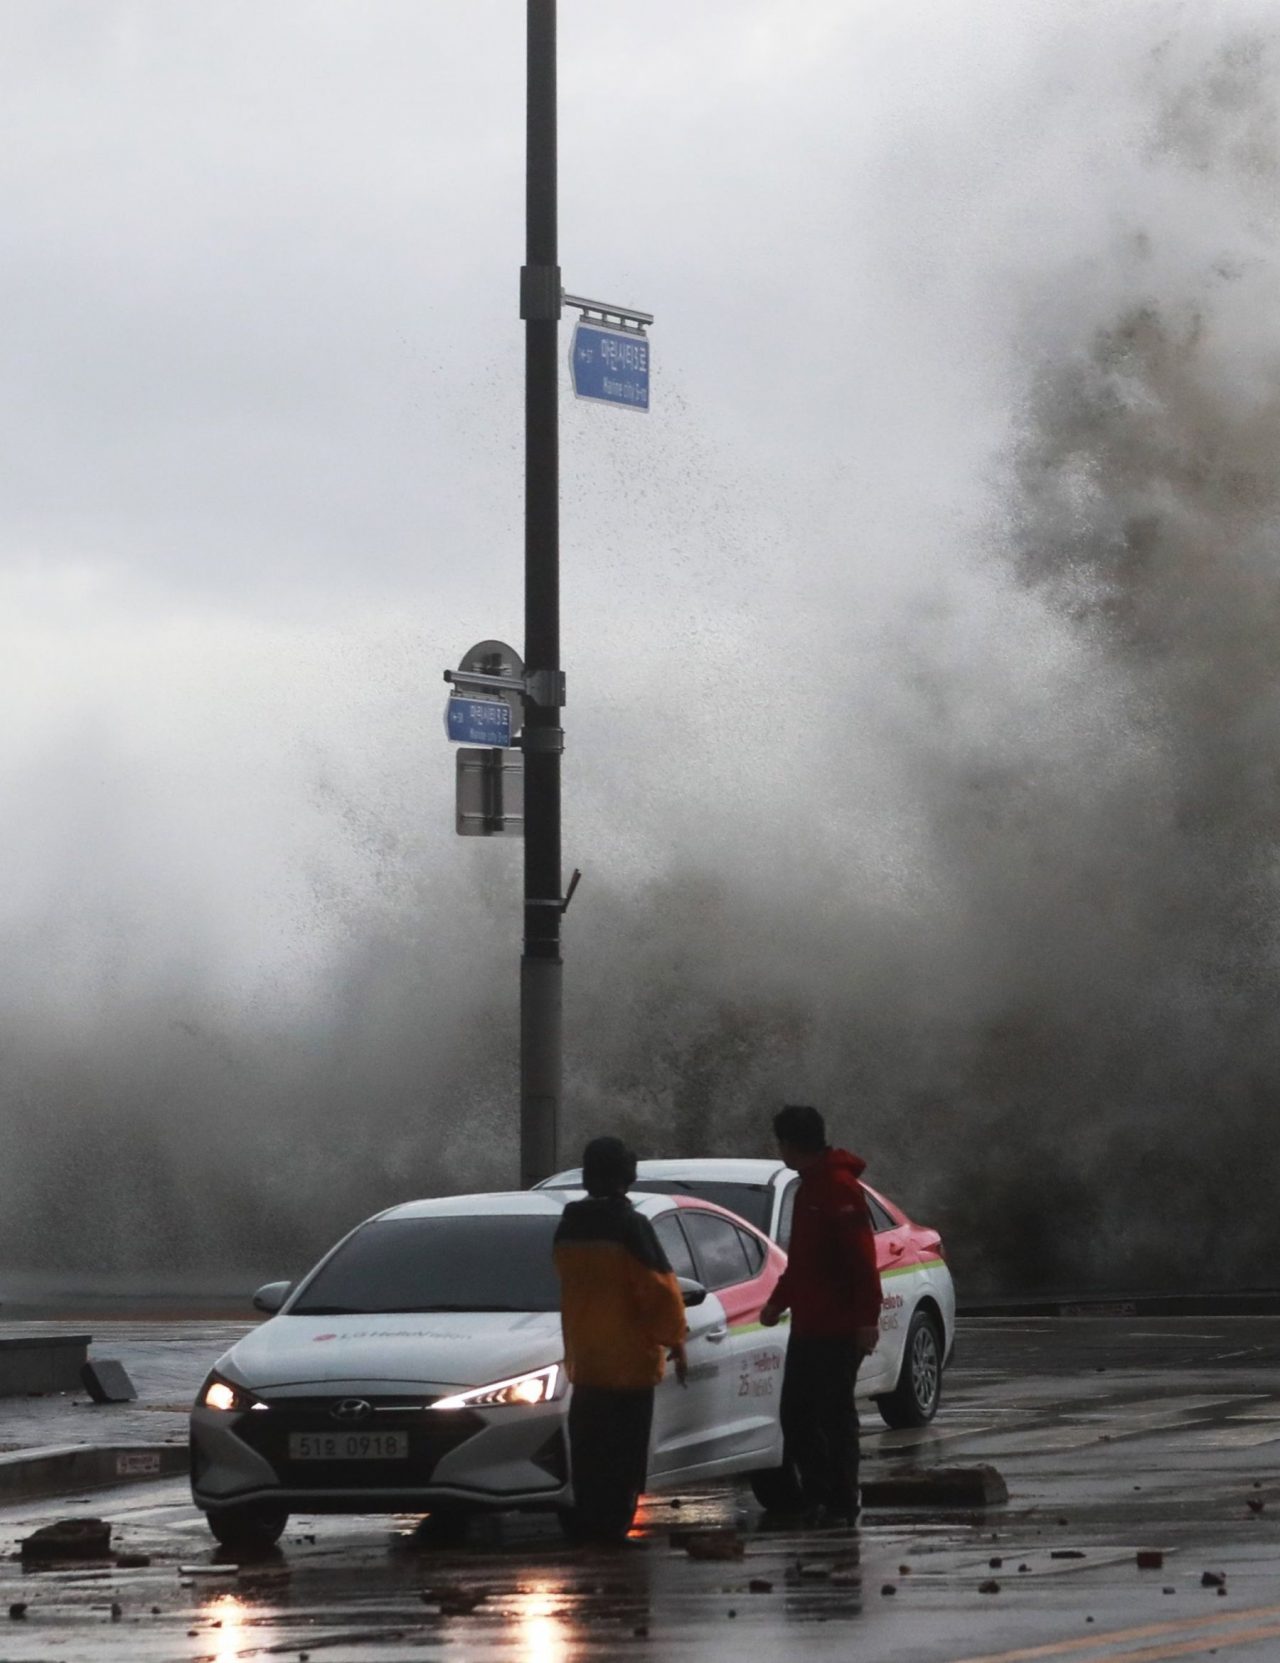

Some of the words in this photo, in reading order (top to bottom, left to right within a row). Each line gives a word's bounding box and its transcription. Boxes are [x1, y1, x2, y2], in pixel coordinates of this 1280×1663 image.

[882, 1293, 896, 1310] ello
[738, 1373, 750, 1397] 25
[346, 1435, 397, 1456] 0918
